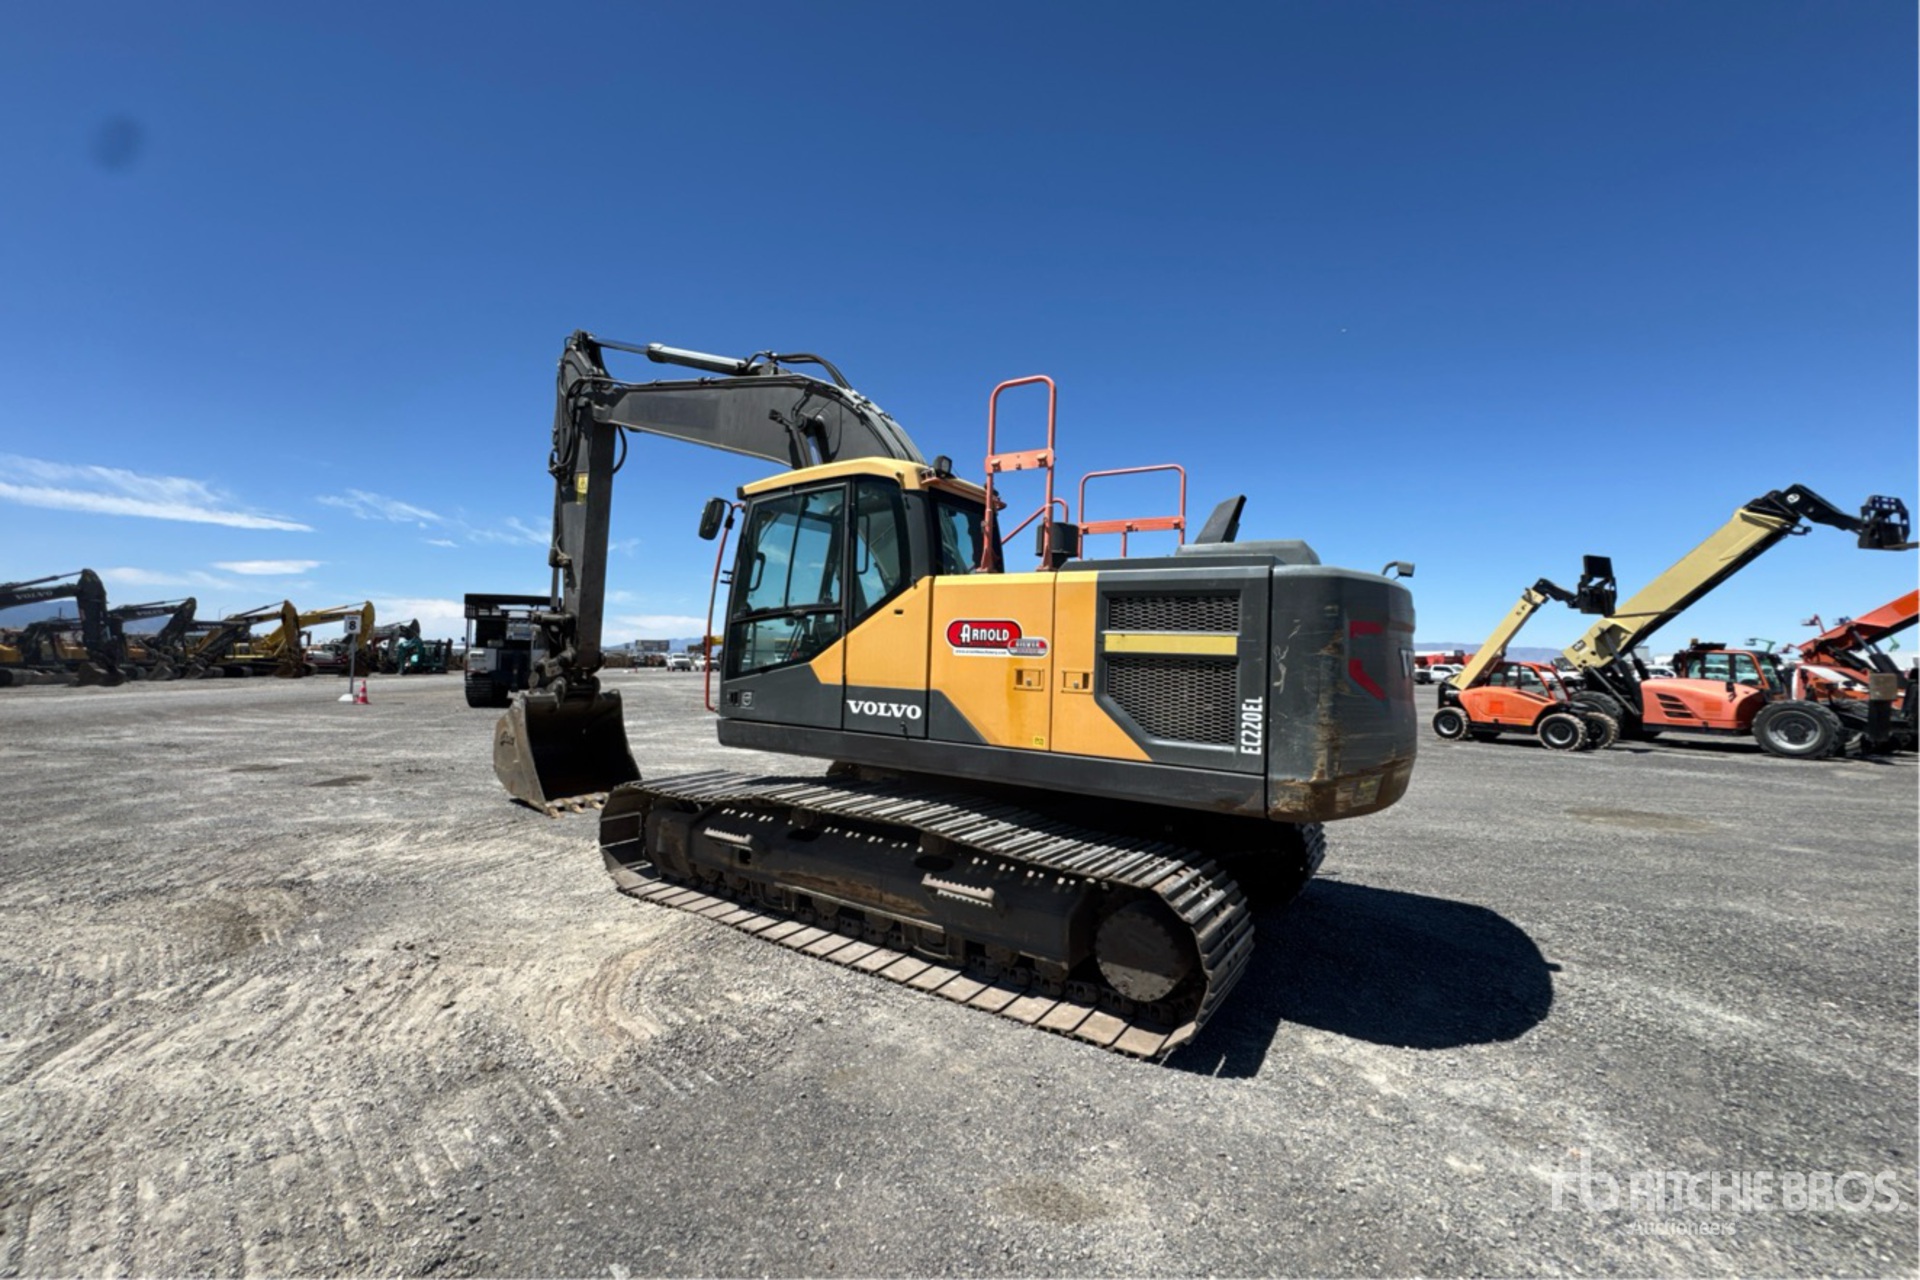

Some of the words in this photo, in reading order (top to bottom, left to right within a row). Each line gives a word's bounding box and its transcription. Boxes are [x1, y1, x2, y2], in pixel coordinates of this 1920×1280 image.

[15, 591, 53, 600] VOLVO
[349, 620, 357, 630] 8
[961, 624, 1010, 643] ARNOLD
[846, 699, 922, 719] VOLVO
[1240, 696, 1263, 755] EC220EL
